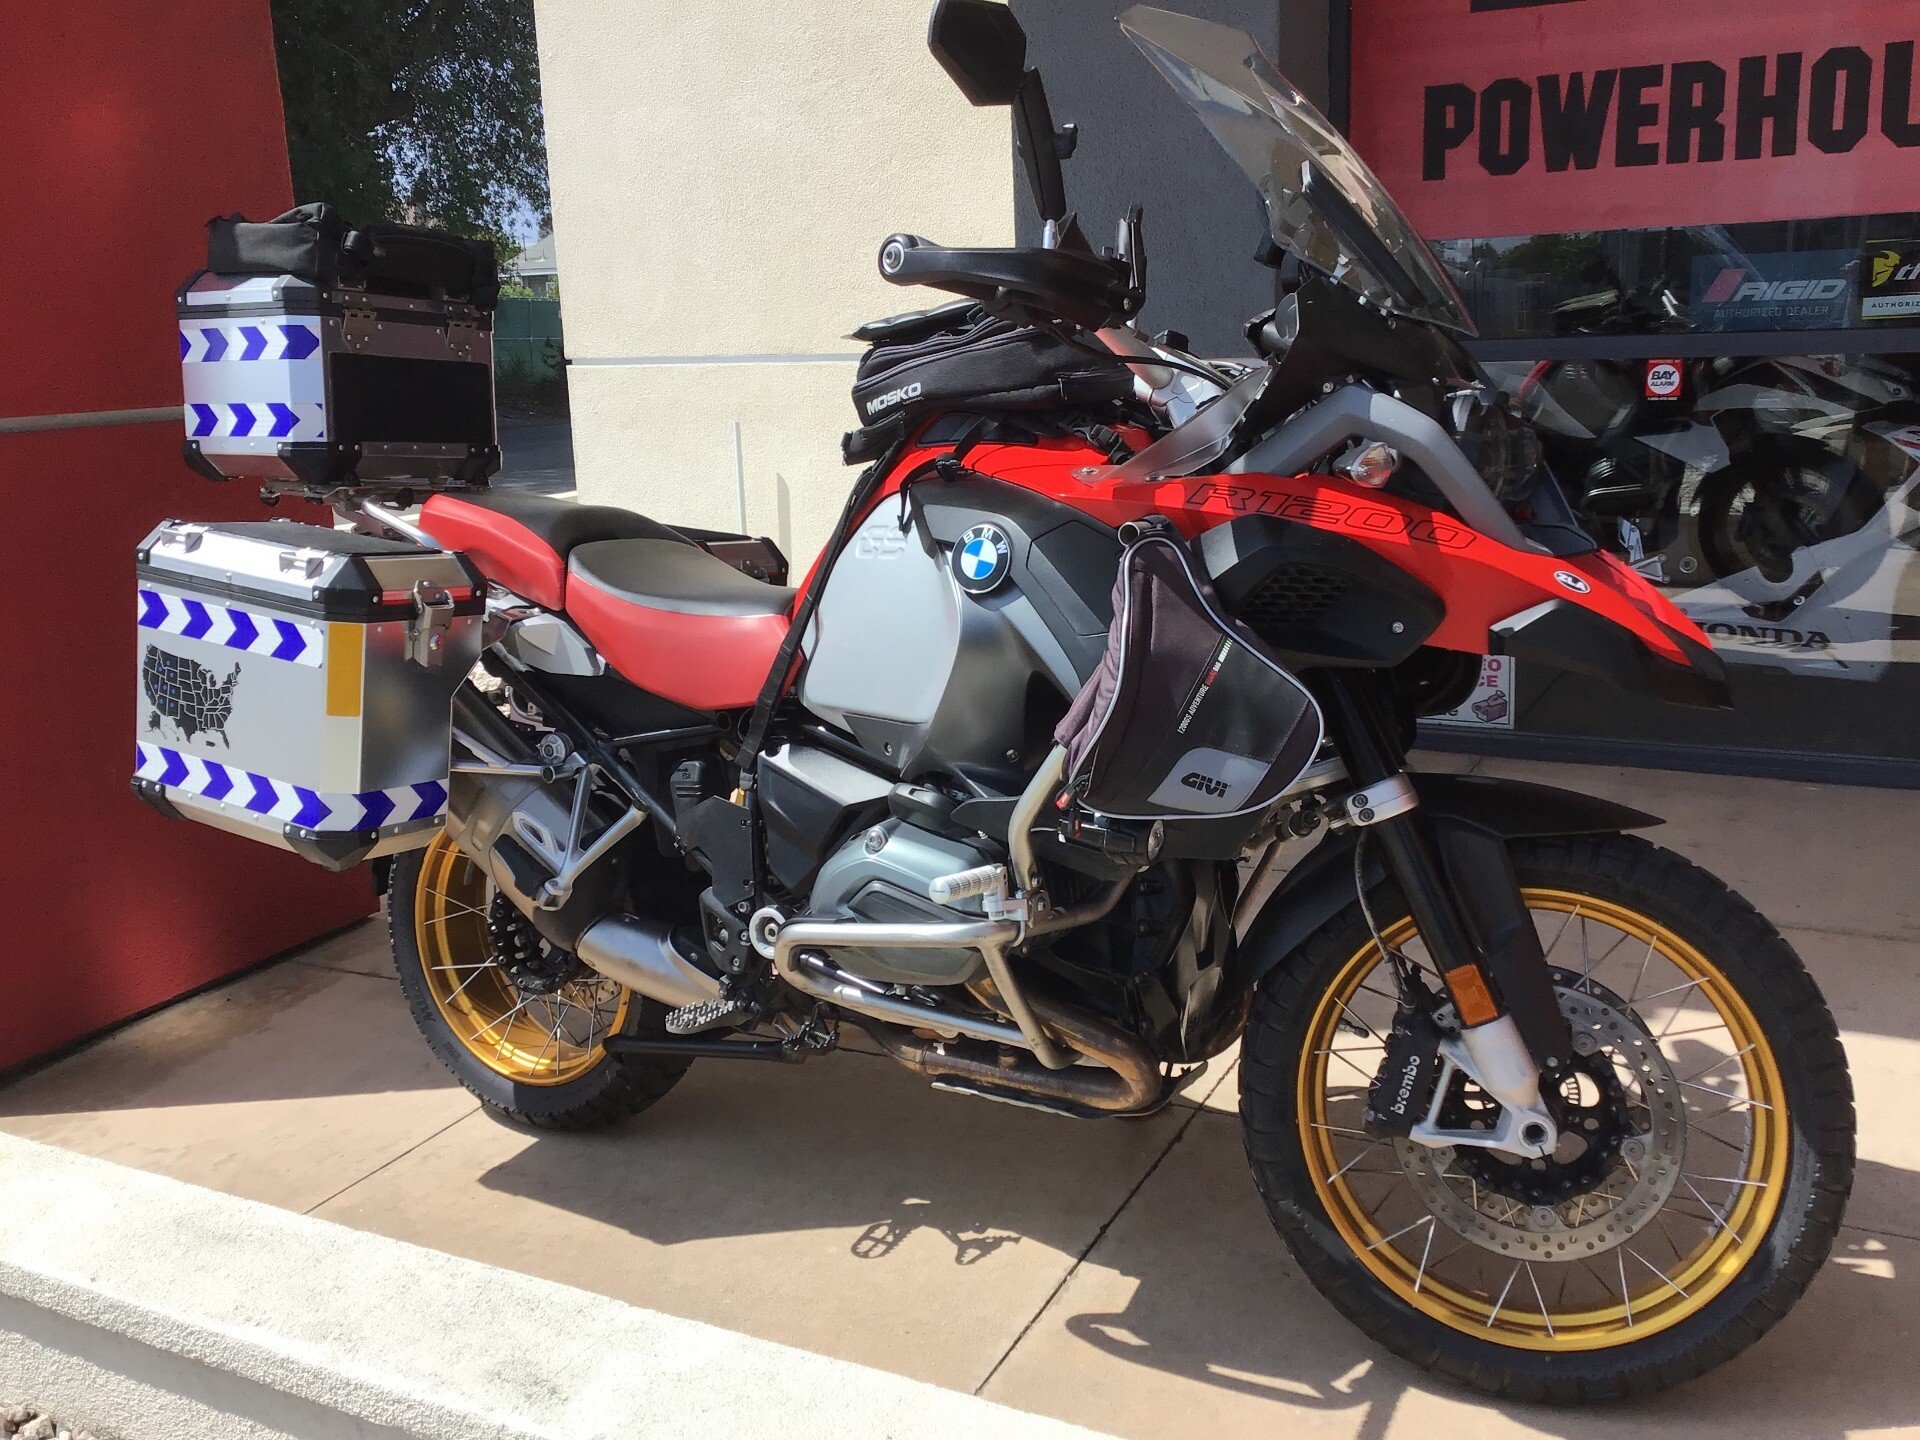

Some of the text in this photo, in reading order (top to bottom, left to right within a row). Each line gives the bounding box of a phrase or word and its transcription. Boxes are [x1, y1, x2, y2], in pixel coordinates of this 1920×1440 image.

[1733, 279, 1847, 302] RIGID
[1786, 306, 1829, 316] DEALER
[1651, 370, 1676, 380] BAY
[866, 382, 922, 416] MOSKO
[1187, 483, 1477, 549] R1200
[963, 526, 1008, 555] BMW
[1177, 713, 1192, 735] 1200GS
[1188, 684, 1210, 716] ADVENTURE
[1181, 772, 1228, 798] GIVI
[1389, 1055, 1420, 1115] brembo
